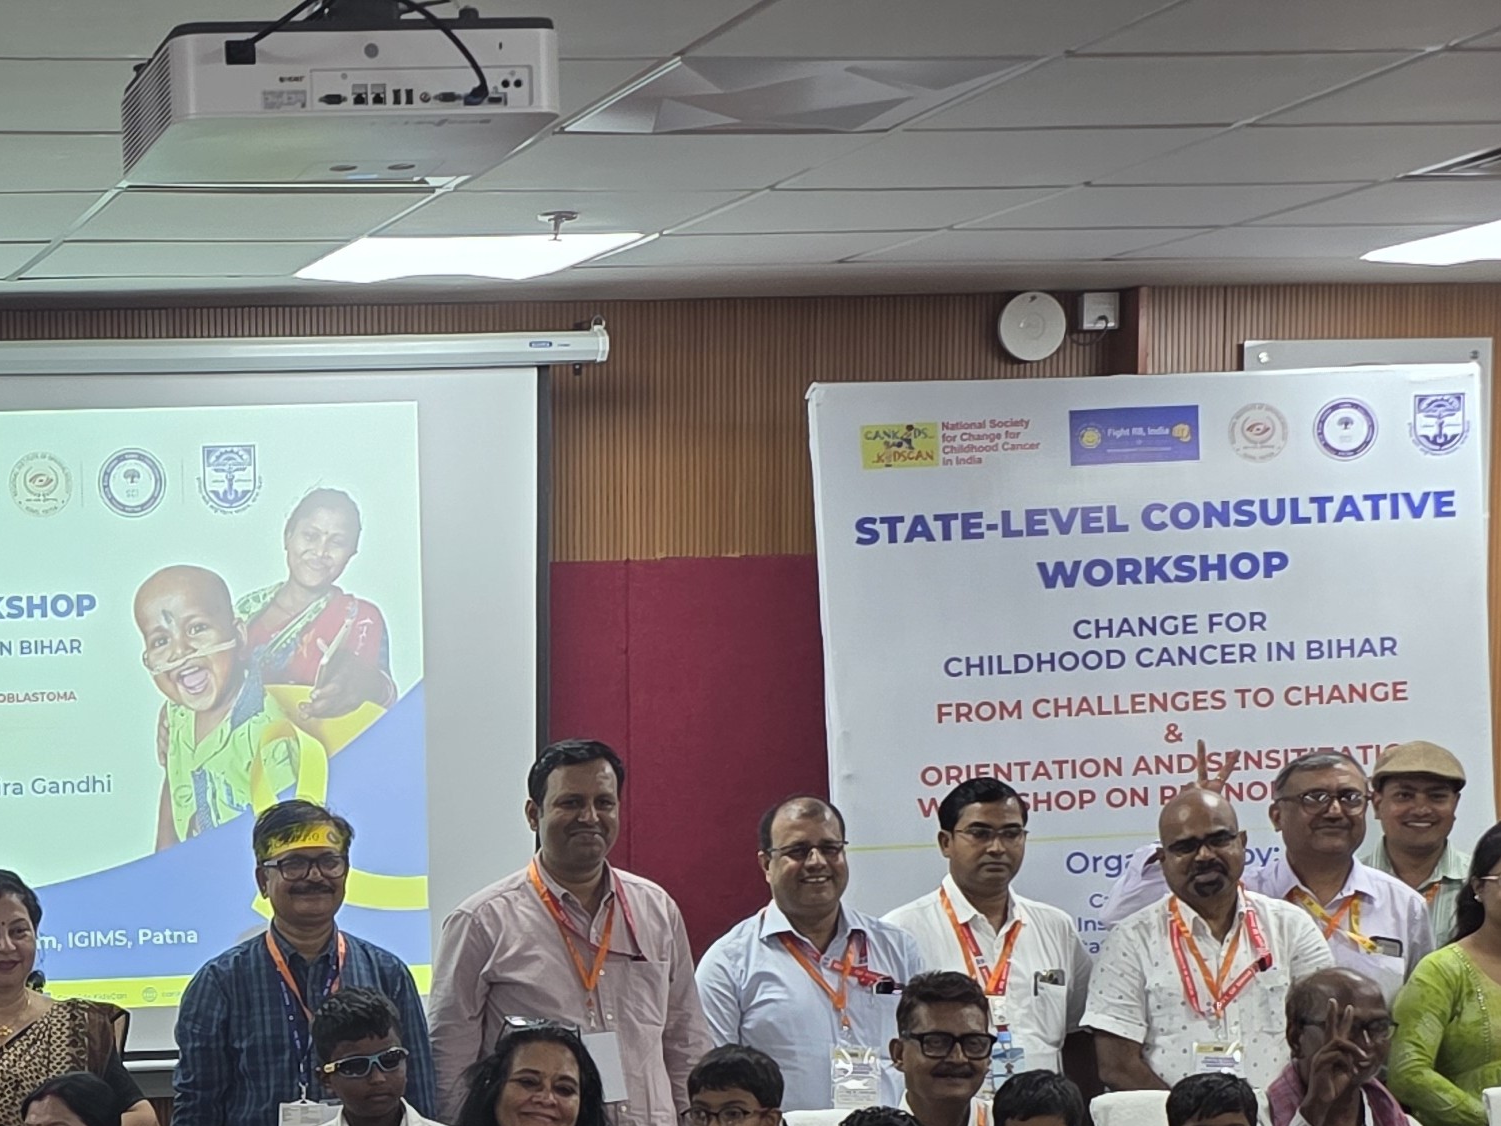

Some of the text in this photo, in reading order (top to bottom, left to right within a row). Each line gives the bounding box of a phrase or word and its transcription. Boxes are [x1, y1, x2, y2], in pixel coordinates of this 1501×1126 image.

[941, 418, 1030, 431] National Society
[942, 430, 1021, 443] for Change for
[942, 441, 1041, 455] Childhood Cancer
[956, 455, 983, 466] India
[855, 489, 1457, 546] STATE-LEVEL CONSULTATIVE
[1036, 551, 1289, 590] WORKSHOP
[1073, 611, 1268, 640] CHANGE FOR
[19, 638, 82, 656] BIHAR
[943, 636, 1398, 678] CHILDHOOD CANCER IN BIHAR
[936, 680, 1409, 724] FROM CHALLENGES TO CHANGE
[1164, 722, 1183, 743] &
[920, 756, 1123, 787] ORIENTATION
[1132, 752, 1198, 776] AND
[31, 774, 112, 795] Gandhi
[1106, 786, 1149, 809] ON
[68, 930, 133, 949] IGIMS,
[138, 928, 198, 946] Patna
